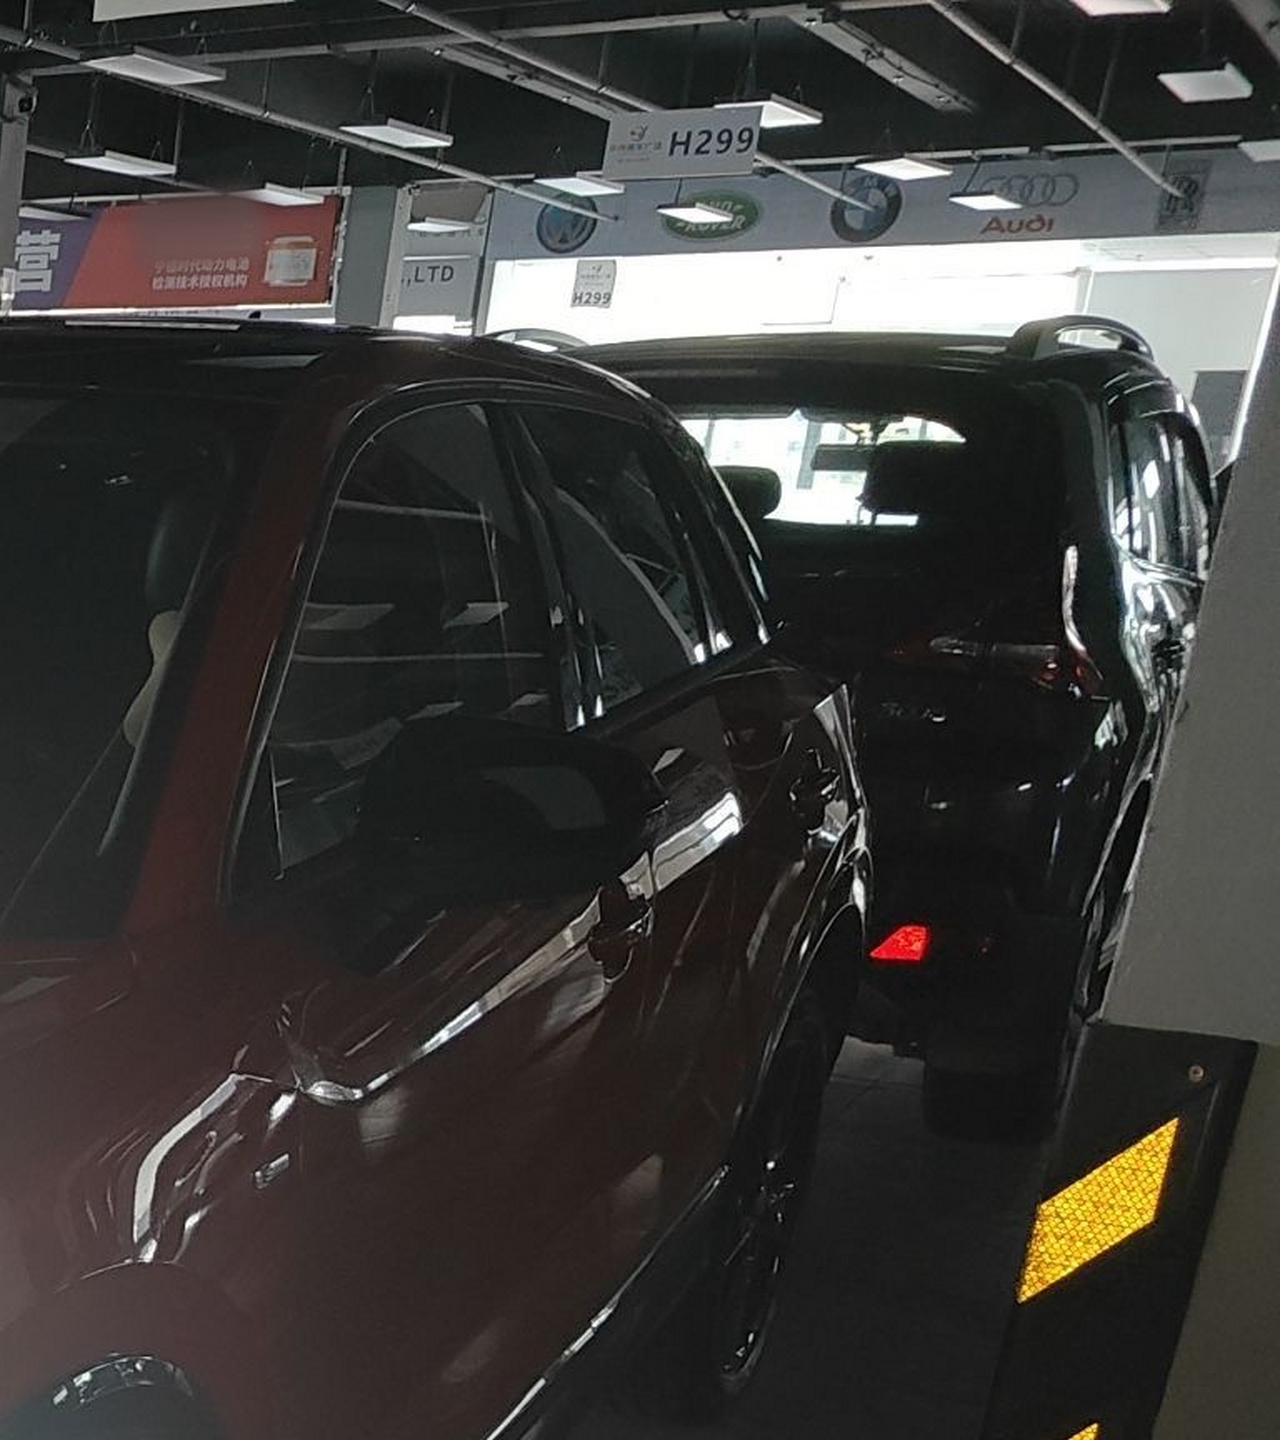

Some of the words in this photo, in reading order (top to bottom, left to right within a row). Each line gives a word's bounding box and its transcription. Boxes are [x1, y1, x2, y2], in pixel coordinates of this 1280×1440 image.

[667, 126, 754, 157] H299
[979, 212, 1056, 236] Audi
[572, 291, 613, 305] H299
